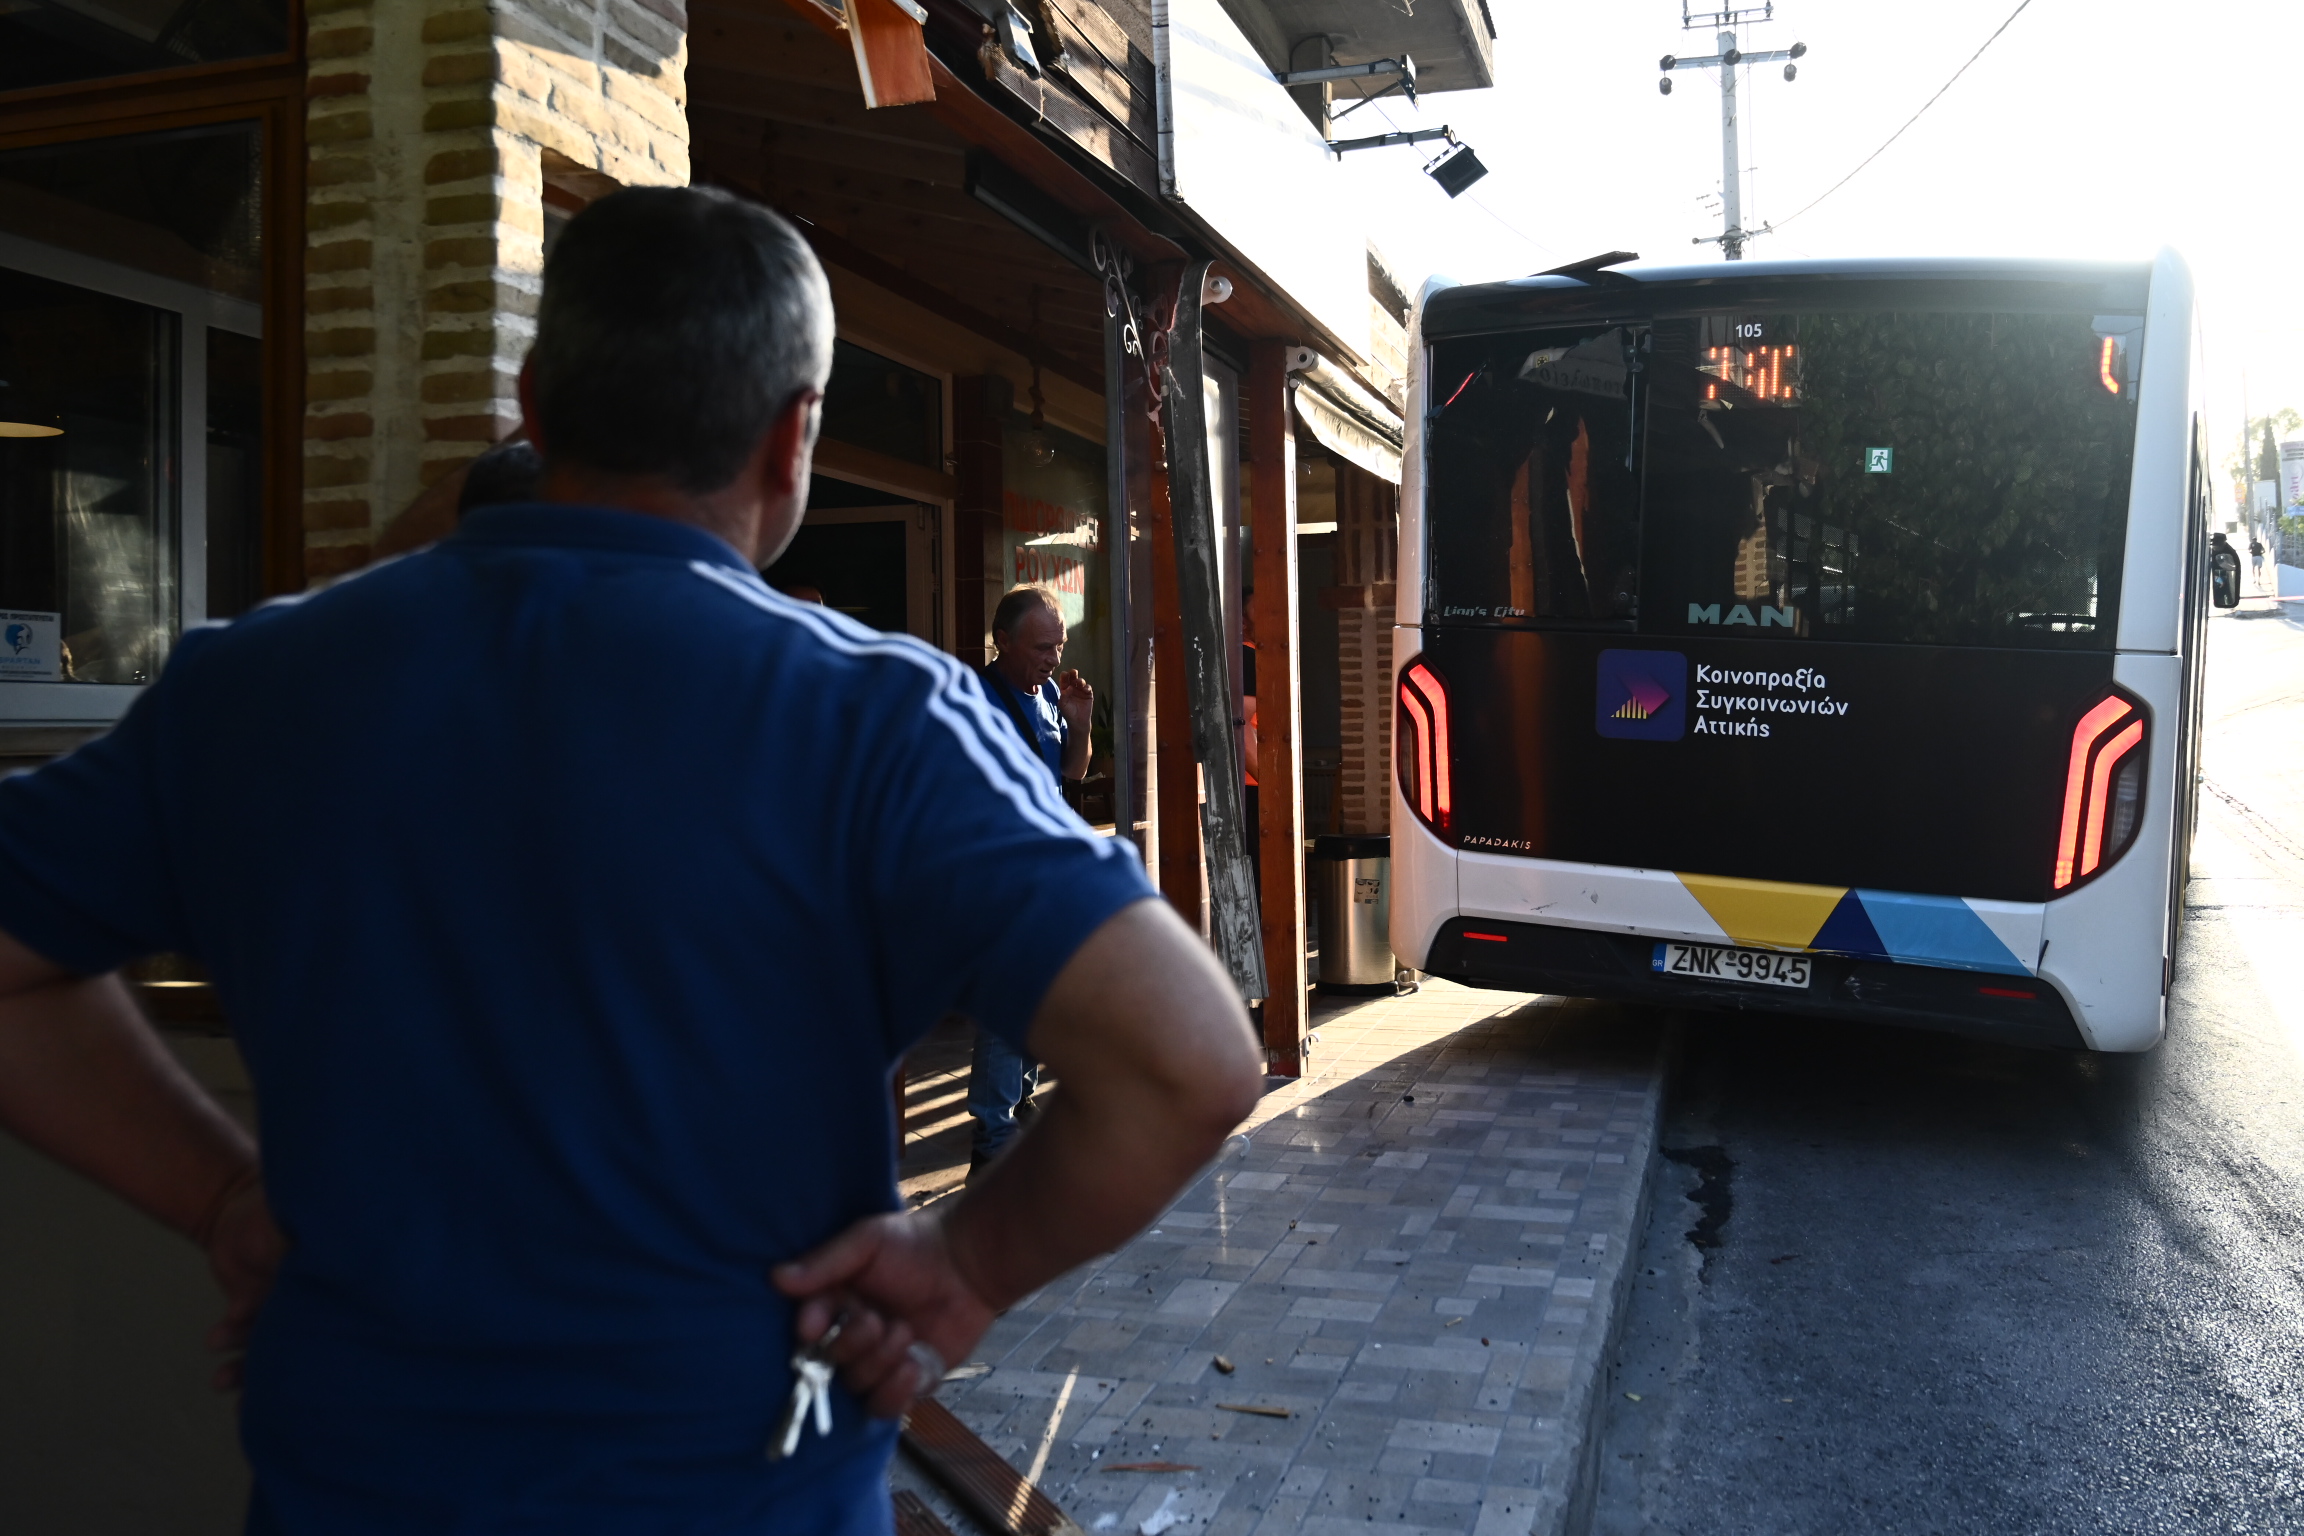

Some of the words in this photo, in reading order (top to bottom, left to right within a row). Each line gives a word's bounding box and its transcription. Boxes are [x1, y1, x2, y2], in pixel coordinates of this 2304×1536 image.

[1735, 323, 1763, 338] 105
[1015, 546, 1085, 595] ΡΟΥΧΩΝ
[1687, 602, 1795, 629] MAN
[1696, 663, 1827, 692] Κοινοπραξία
[1695, 689, 1849, 716] Συγκοινωνιών
[1693, 715, 1771, 738] Αττικής
[1463, 835, 1532, 850] PAPADAKIS
[1652, 958, 1664, 968] GR
